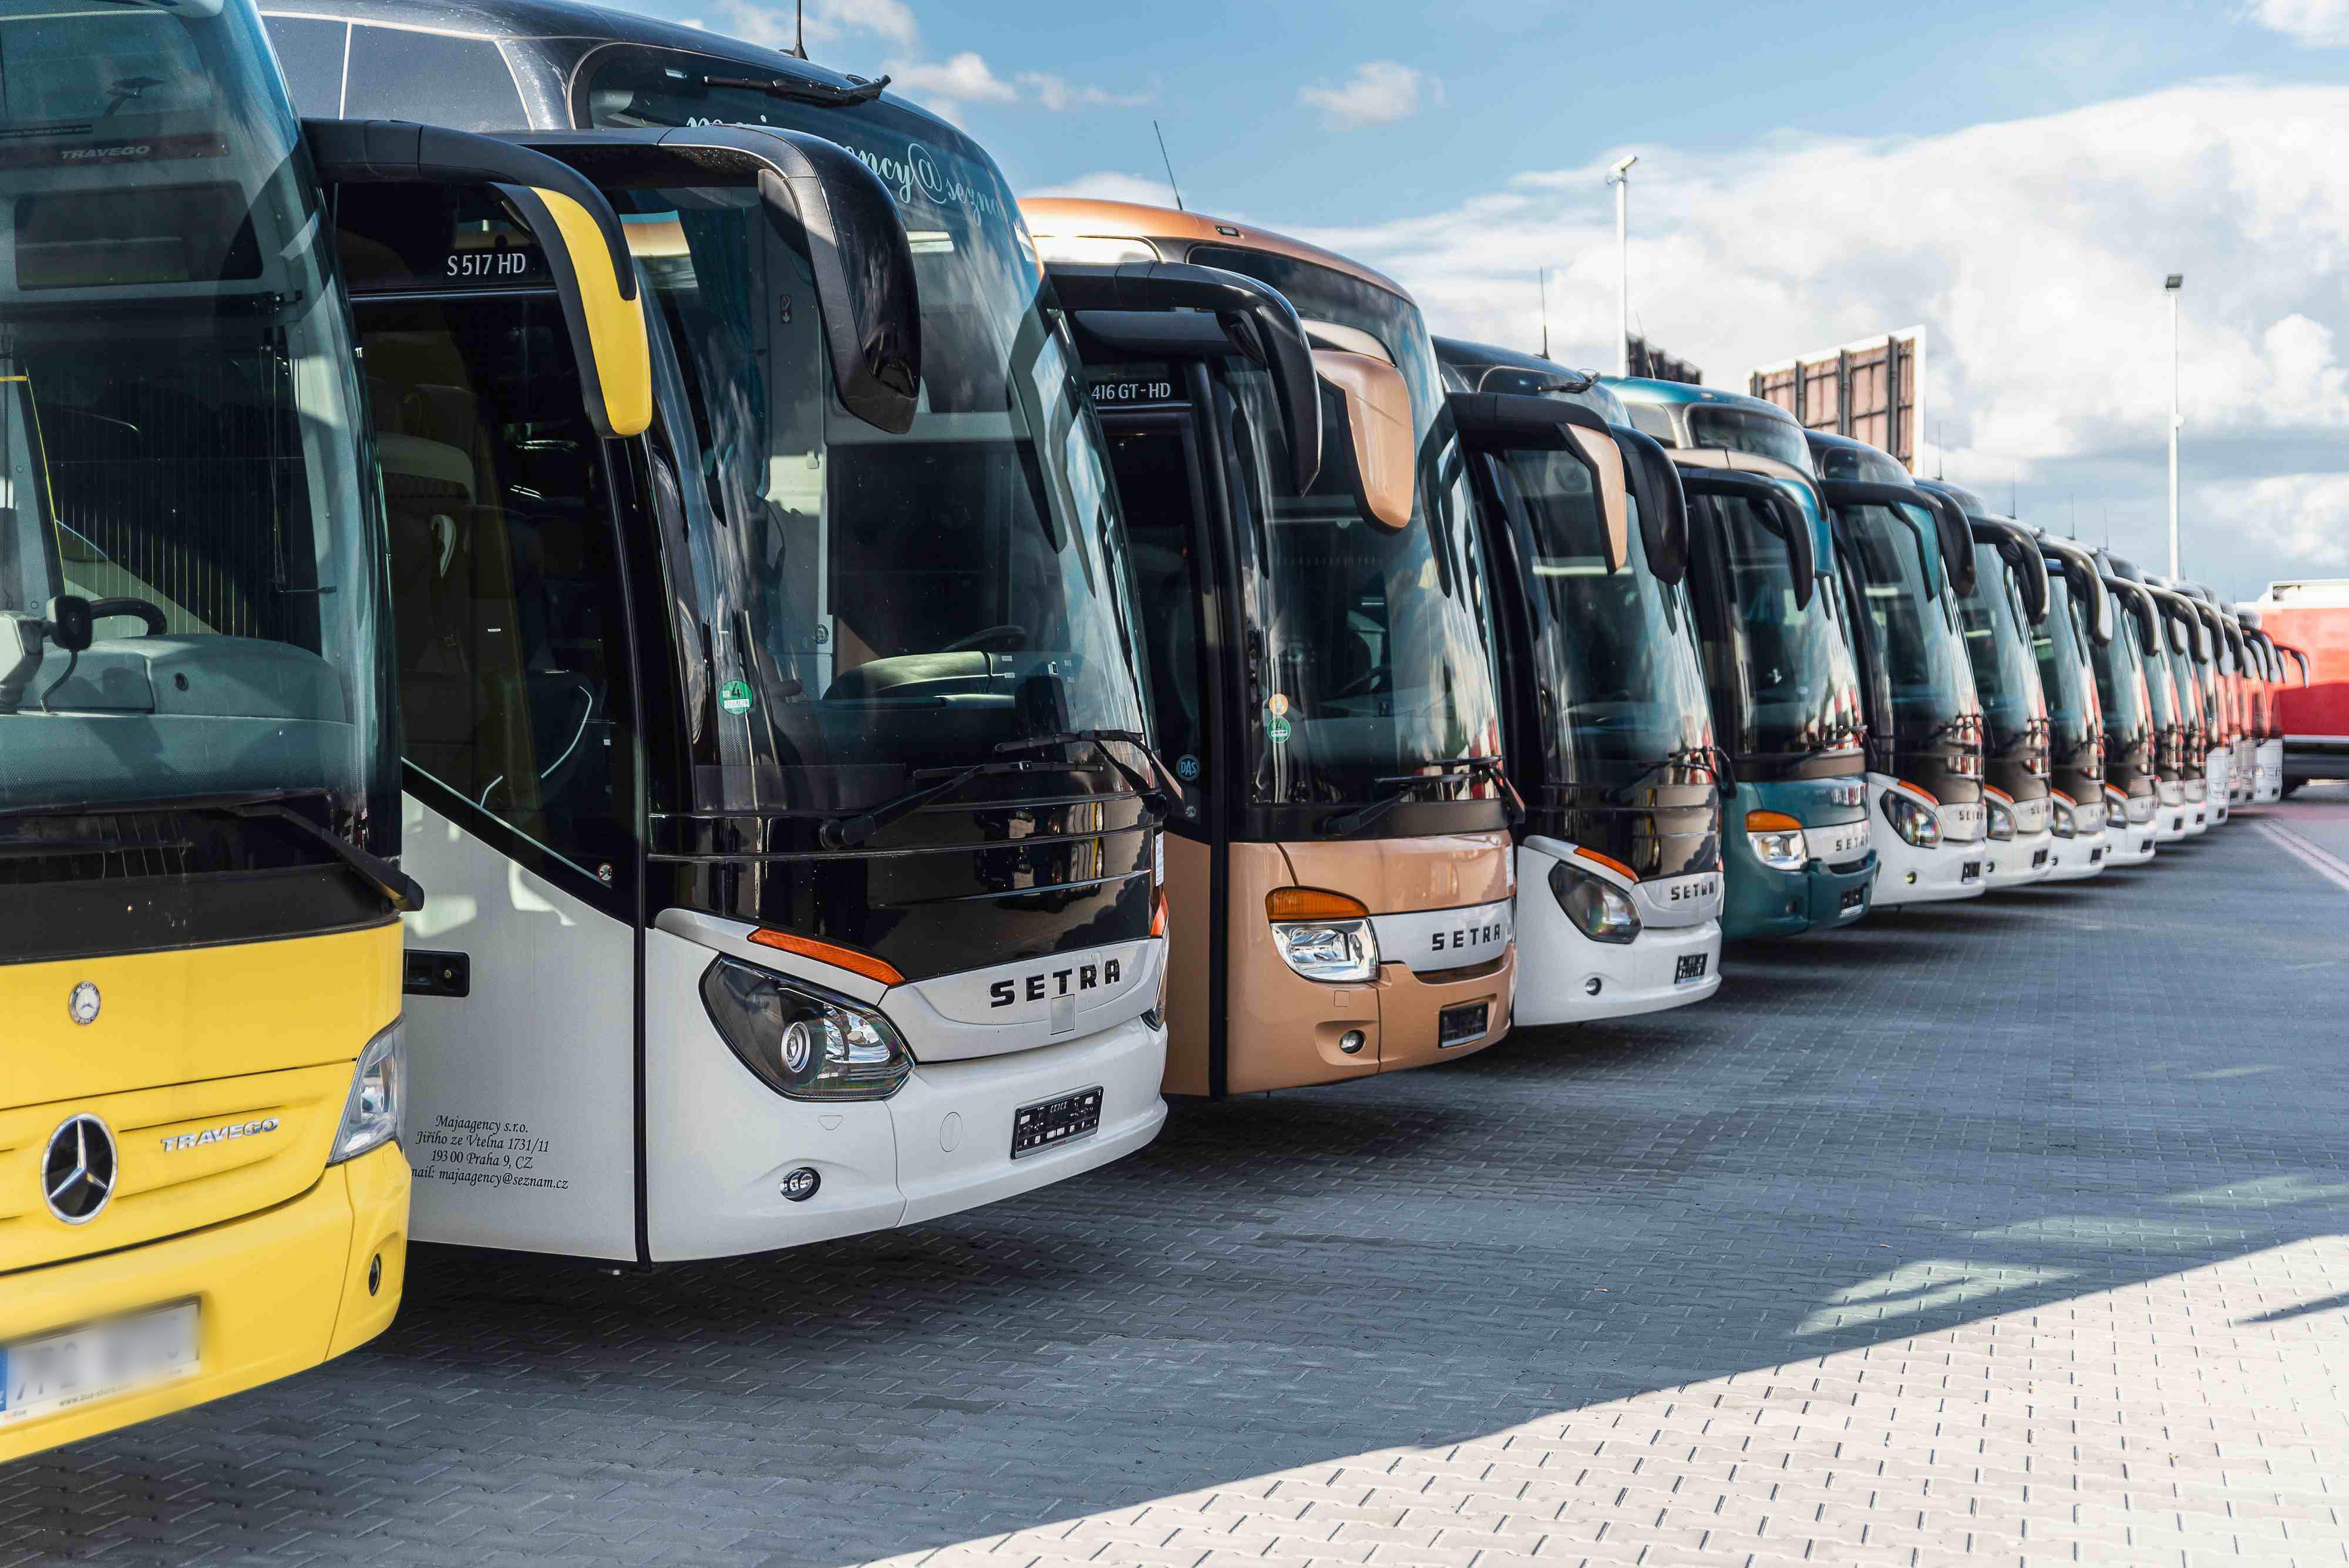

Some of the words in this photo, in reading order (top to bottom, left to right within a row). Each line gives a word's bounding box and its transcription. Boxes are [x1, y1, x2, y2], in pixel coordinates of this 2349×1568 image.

[61, 146, 150, 160] TRAVEGO
[447, 255, 458, 276] S
[462, 254, 493, 275] 517
[497, 253, 526, 274] HD
[1092, 385, 1115, 400] 416
[1180, 760, 1196, 776] DAS
[1671, 881, 1715, 901] SETRA
[1432, 923, 1500, 952] SETRA
[990, 958, 1120, 1008] SETRA
[160, 1118, 280, 1153] TRAVEGO
[435, 1115, 501, 1135] Majaagency
[504, 1122, 529, 1133] s.r.o.
[415, 1131, 447, 1145] Jiřího
[450, 1136, 463, 1146] ze
[466, 1134, 504, 1149] Vtelna
[507, 1137, 550, 1154] 1731/11
[450, 1151, 464, 1163] 00
[466, 1152, 500, 1166] Praha
[503, 1155, 512, 1170] 9,
[516, 1156, 533, 1169] CZ
[439, 1167, 569, 1189] majaagency@seznam.cz
